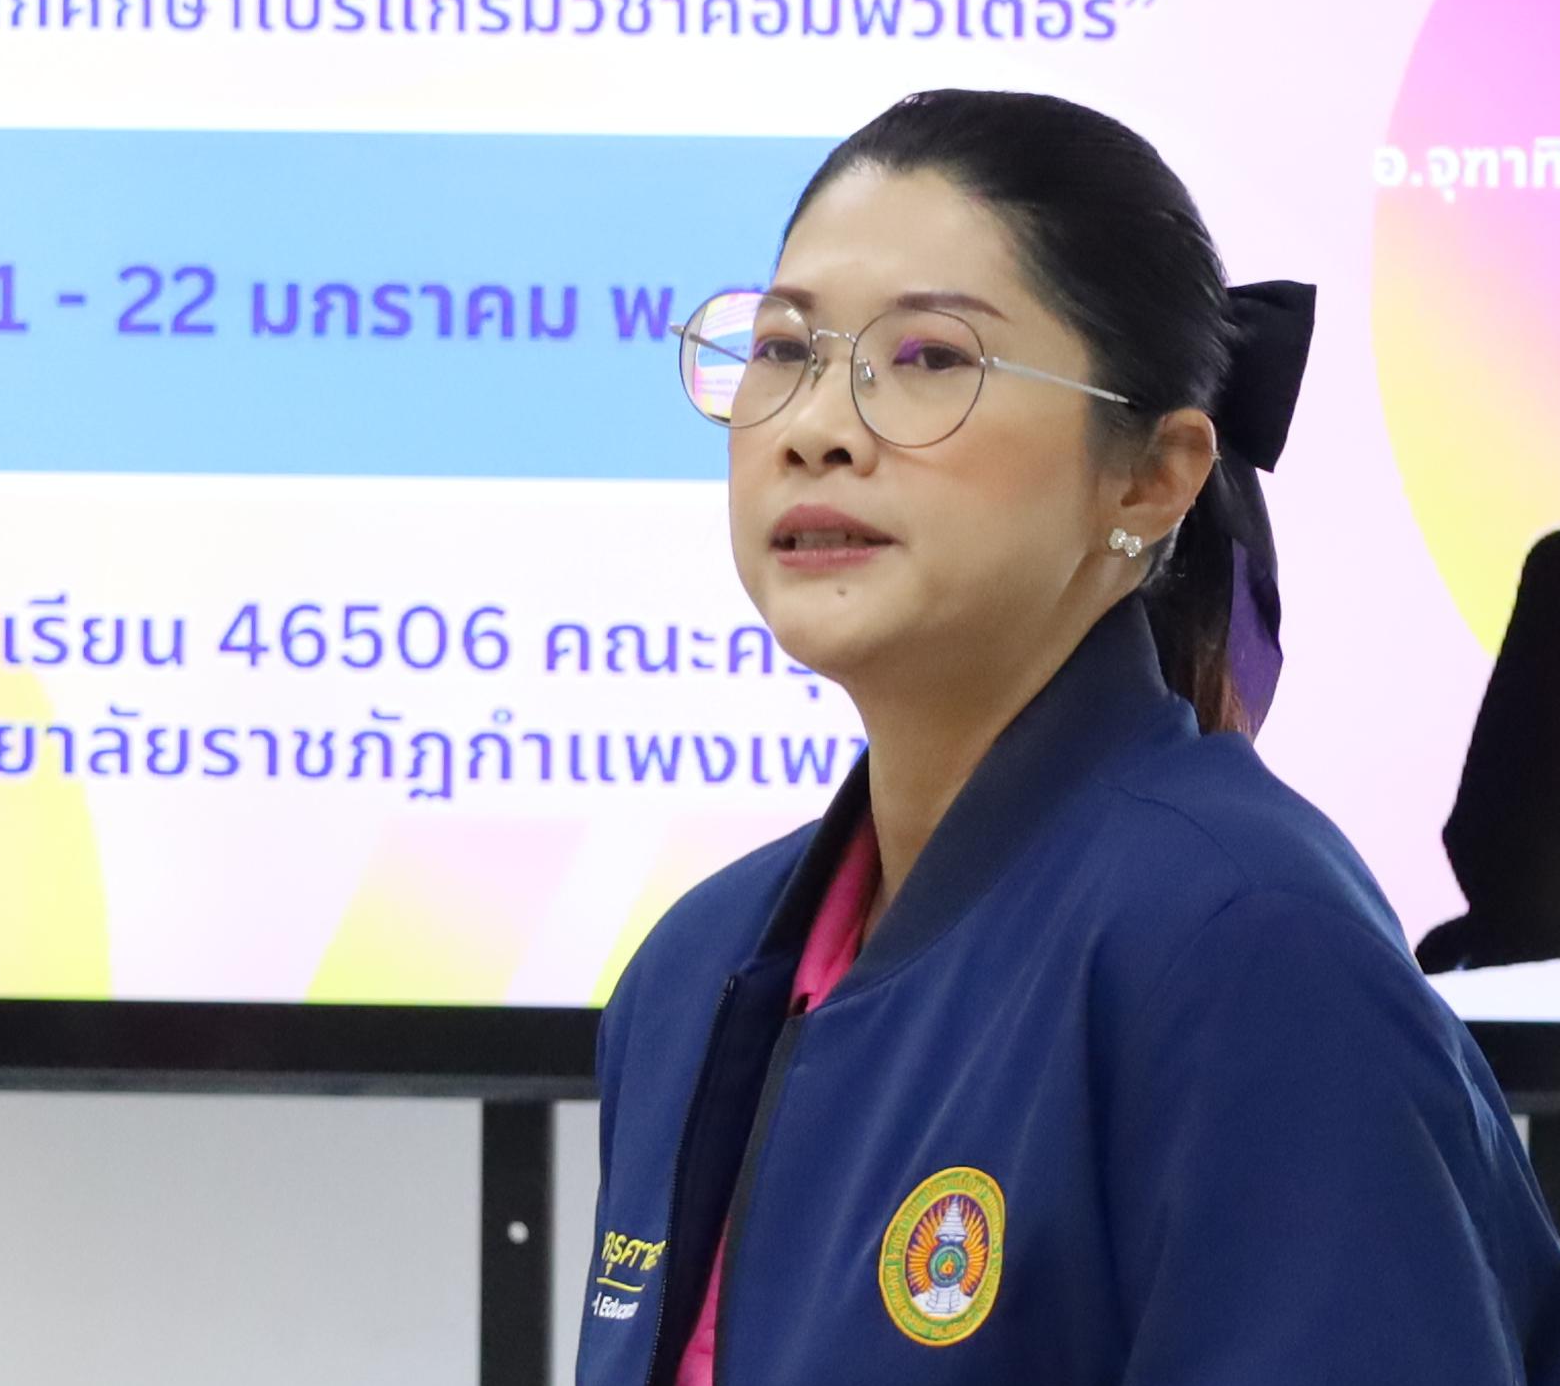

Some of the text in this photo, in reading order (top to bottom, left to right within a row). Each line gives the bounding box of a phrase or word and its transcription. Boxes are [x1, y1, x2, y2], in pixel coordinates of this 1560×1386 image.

[57, 292, 88, 307] -
[116, 263, 218, 337] 22
[250, 281, 579, 341] มกราคม
[217, 602, 511, 672] 46506
